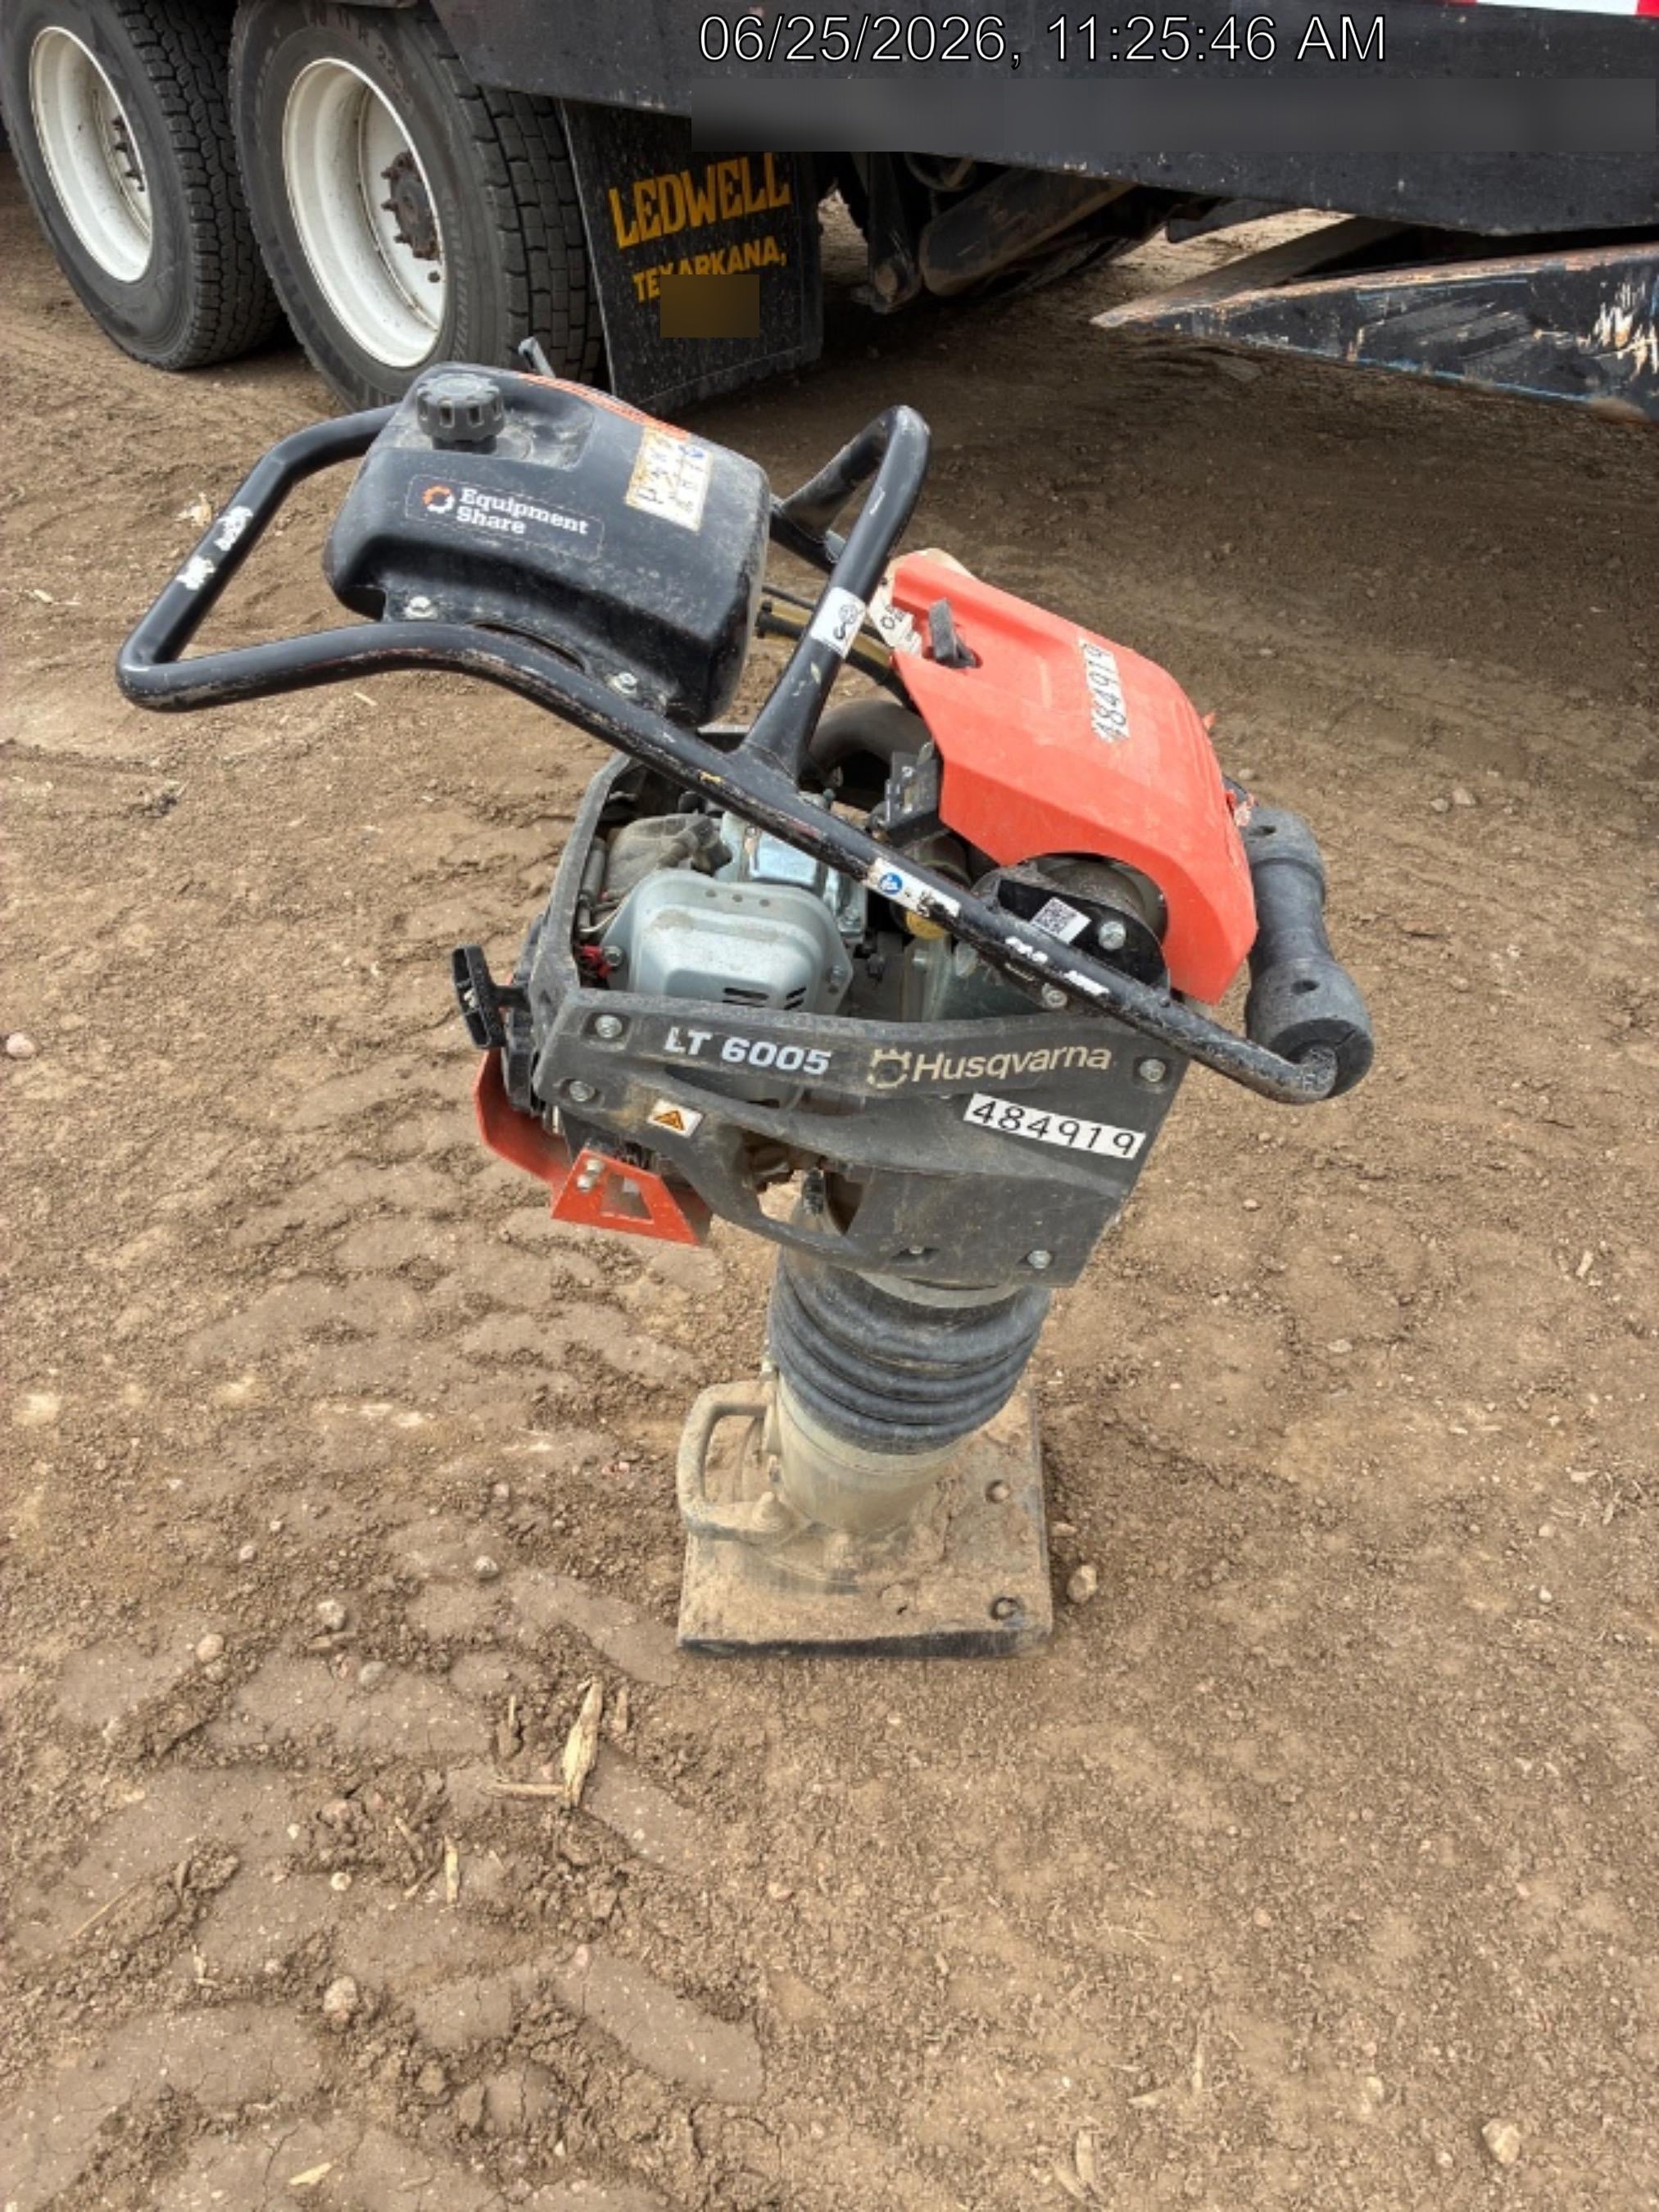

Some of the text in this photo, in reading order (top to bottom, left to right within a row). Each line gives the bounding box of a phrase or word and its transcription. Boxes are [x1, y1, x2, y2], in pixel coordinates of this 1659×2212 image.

[608, 152, 792, 250] LEDWELL
[456, 505, 527, 534] Share
[460, 487, 589, 536] Equipment
[664, 1027, 832, 1076] LT 6005
[911, 1045, 1113, 1082] Husqvarna
[972, 1099, 1137, 1157] 484919
